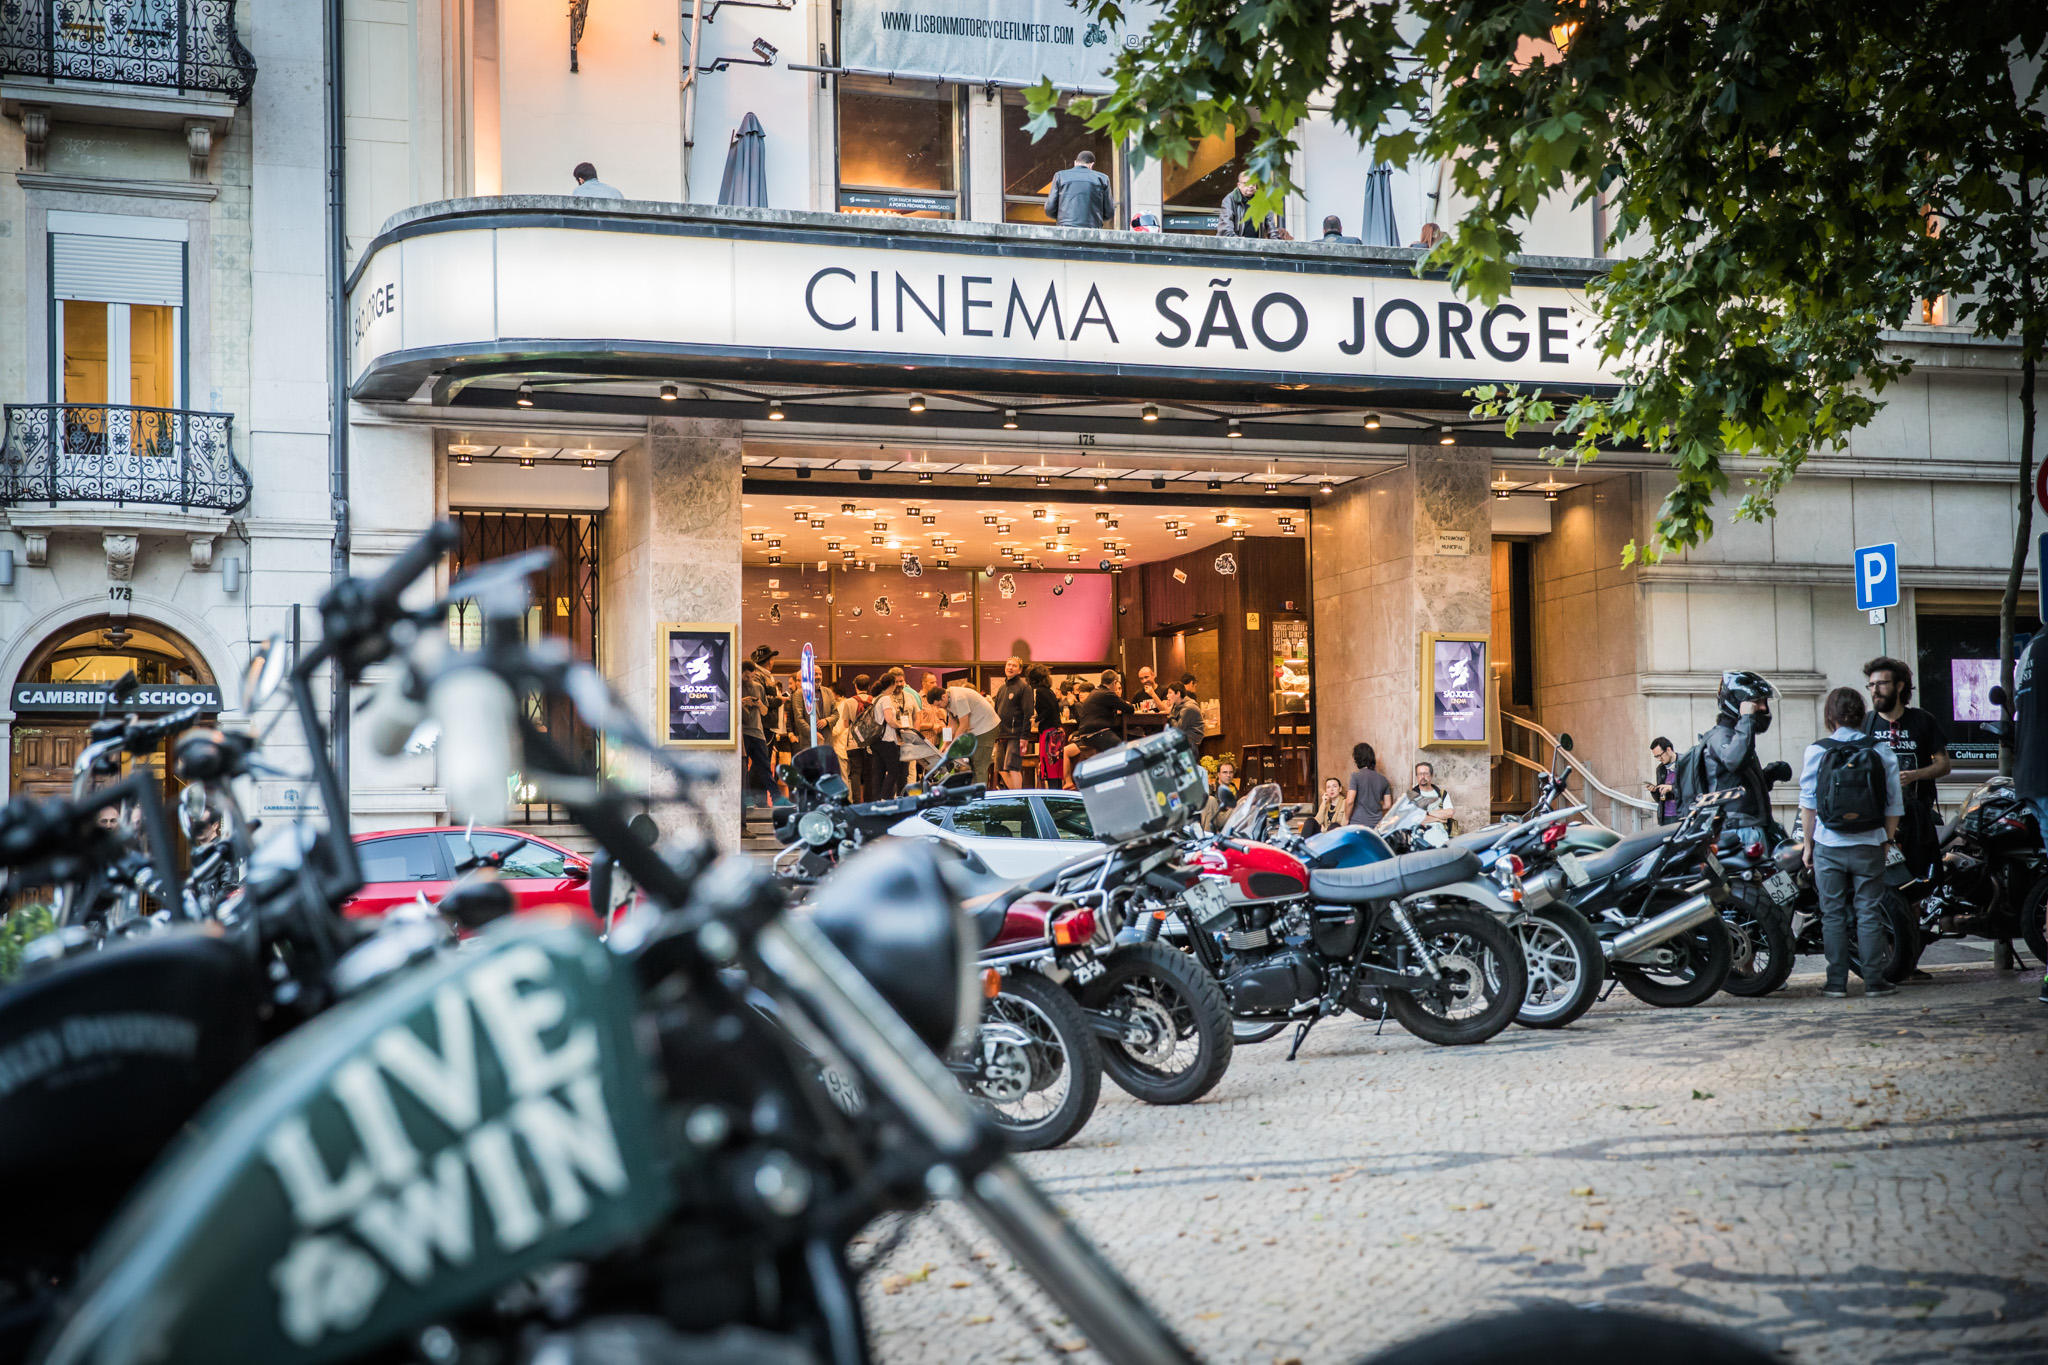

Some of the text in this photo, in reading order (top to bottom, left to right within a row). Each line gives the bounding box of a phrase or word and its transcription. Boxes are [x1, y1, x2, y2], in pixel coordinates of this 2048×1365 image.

[881, 11, 1074, 45] WWW.LISBONMOTORCYCLEFILMFEST.COM
[805, 267, 1569, 364] CINEMA SÃO JORGE
[1079, 434, 1095, 446] 175
[1863, 552, 1887, 603] P
[109, 587, 133, 601] 173
[680, 685, 717, 693] SÃO JORGE
[139, 690, 217, 705] SCHOOL
[1955, 751, 1984, 759] Cultura
[1771, 875, 1783, 888] 02
[1193, 884, 1209, 901] 59
[263, 943, 600, 1228] LIVE
[352, 1072, 630, 1288] WIN
